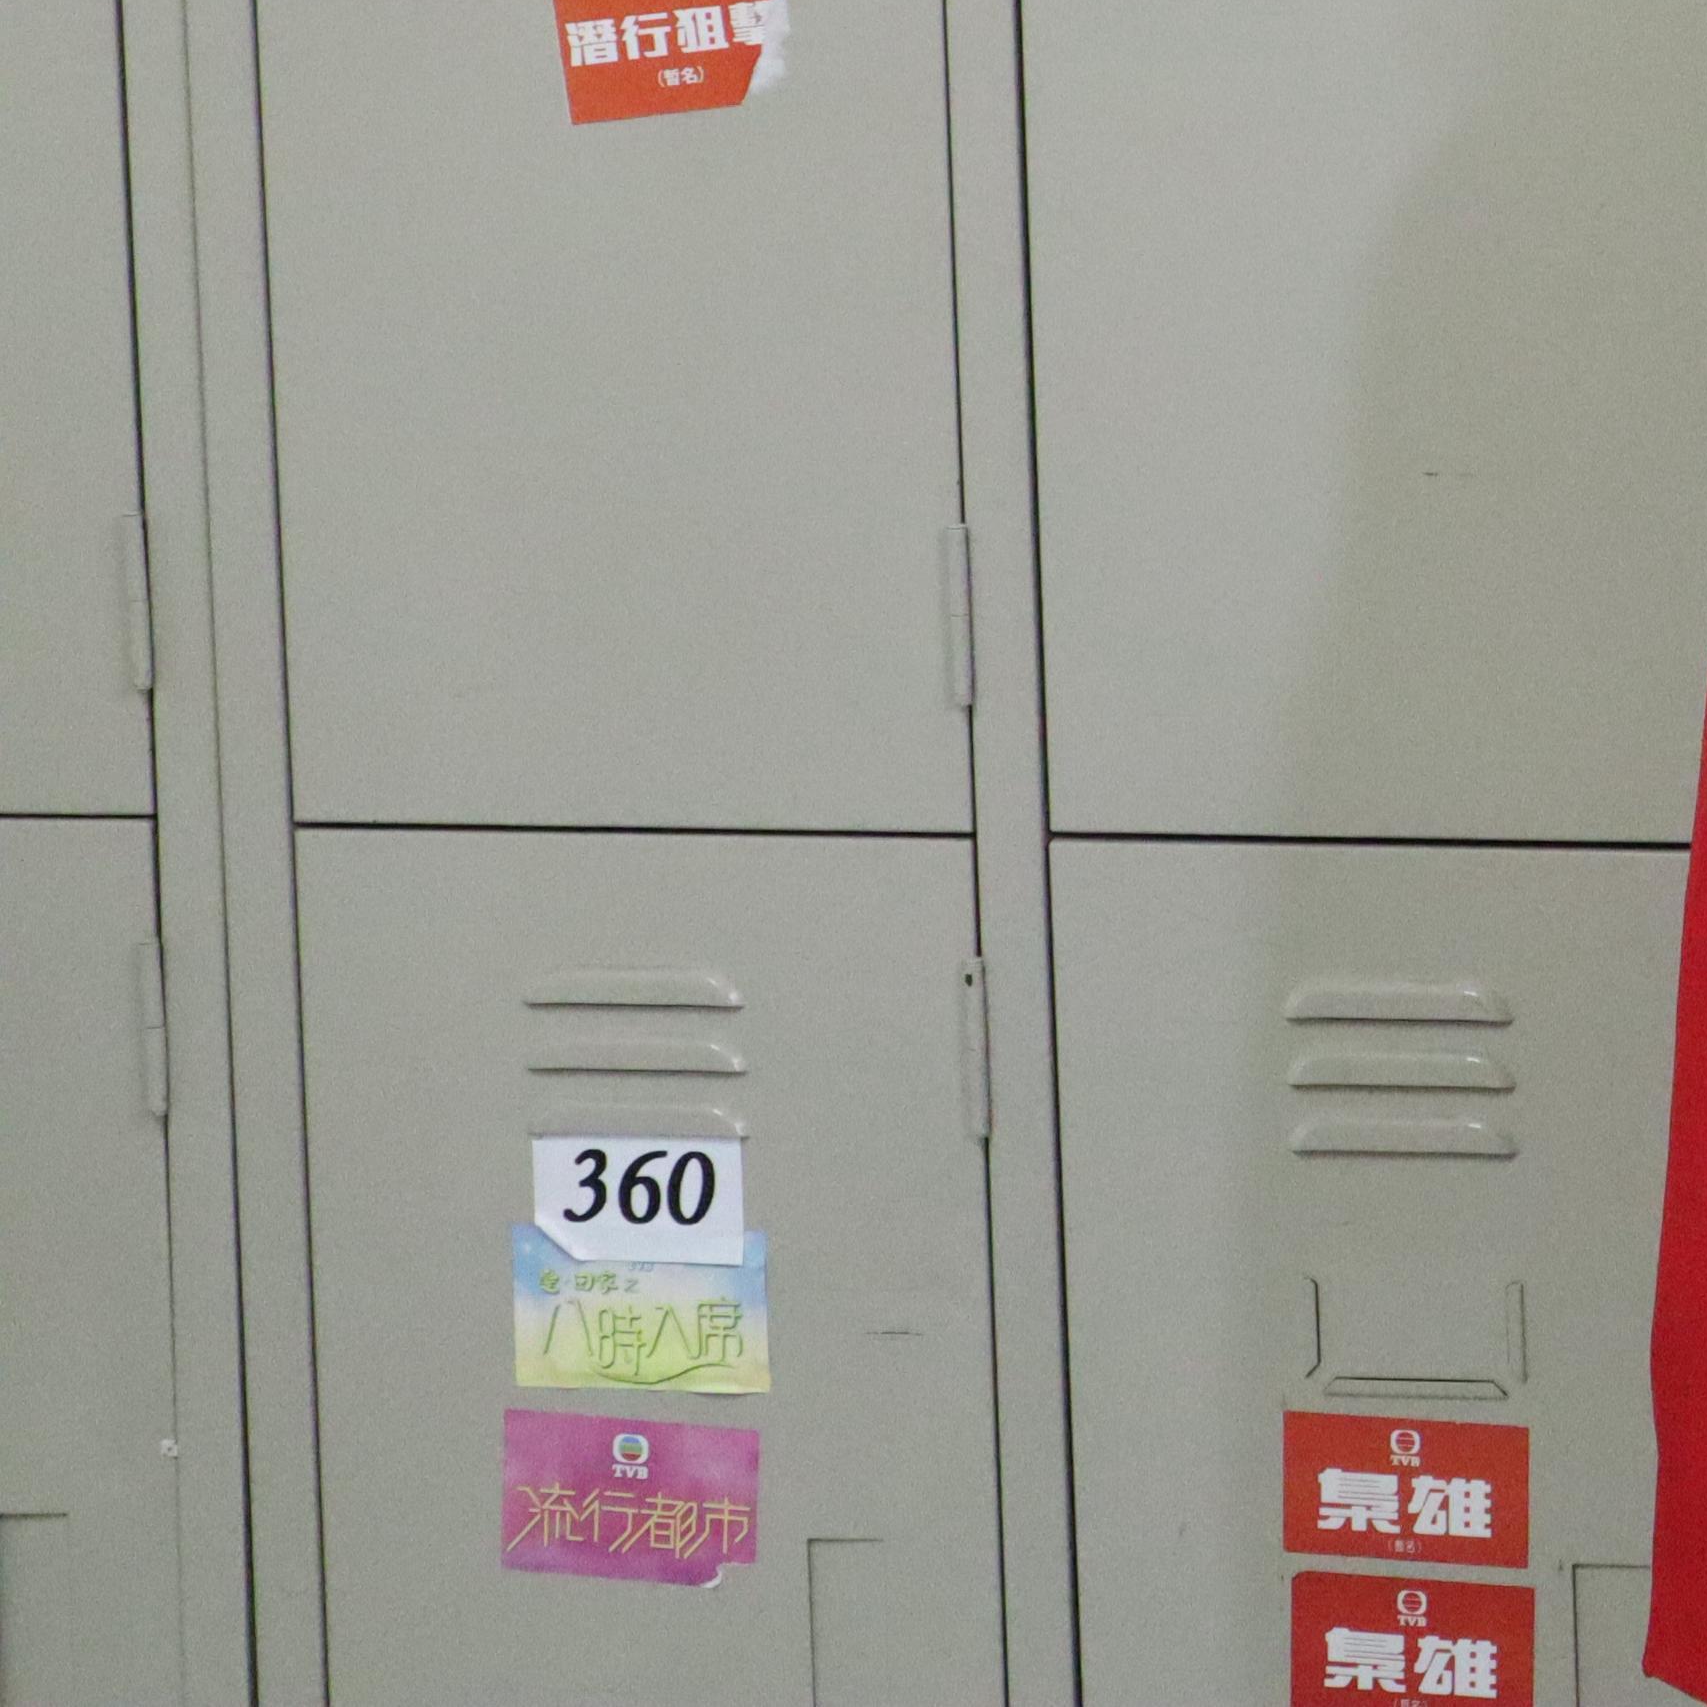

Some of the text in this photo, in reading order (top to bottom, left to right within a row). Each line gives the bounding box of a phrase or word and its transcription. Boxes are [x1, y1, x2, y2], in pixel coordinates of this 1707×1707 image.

[565, 1, 767, 67] 潛行狙擊
[563, 1149, 716, 1226] 360
[612, 1465, 649, 1480] TVB
[1390, 1456, 1421, 1468] TVB
[506, 1483, 751, 1560] 流行都市
[1317, 1468, 1492, 1538] 梟雄
[1398, 1615, 1428, 1627] TVB
[1324, 1627, 1498, 1699] 梟雄
